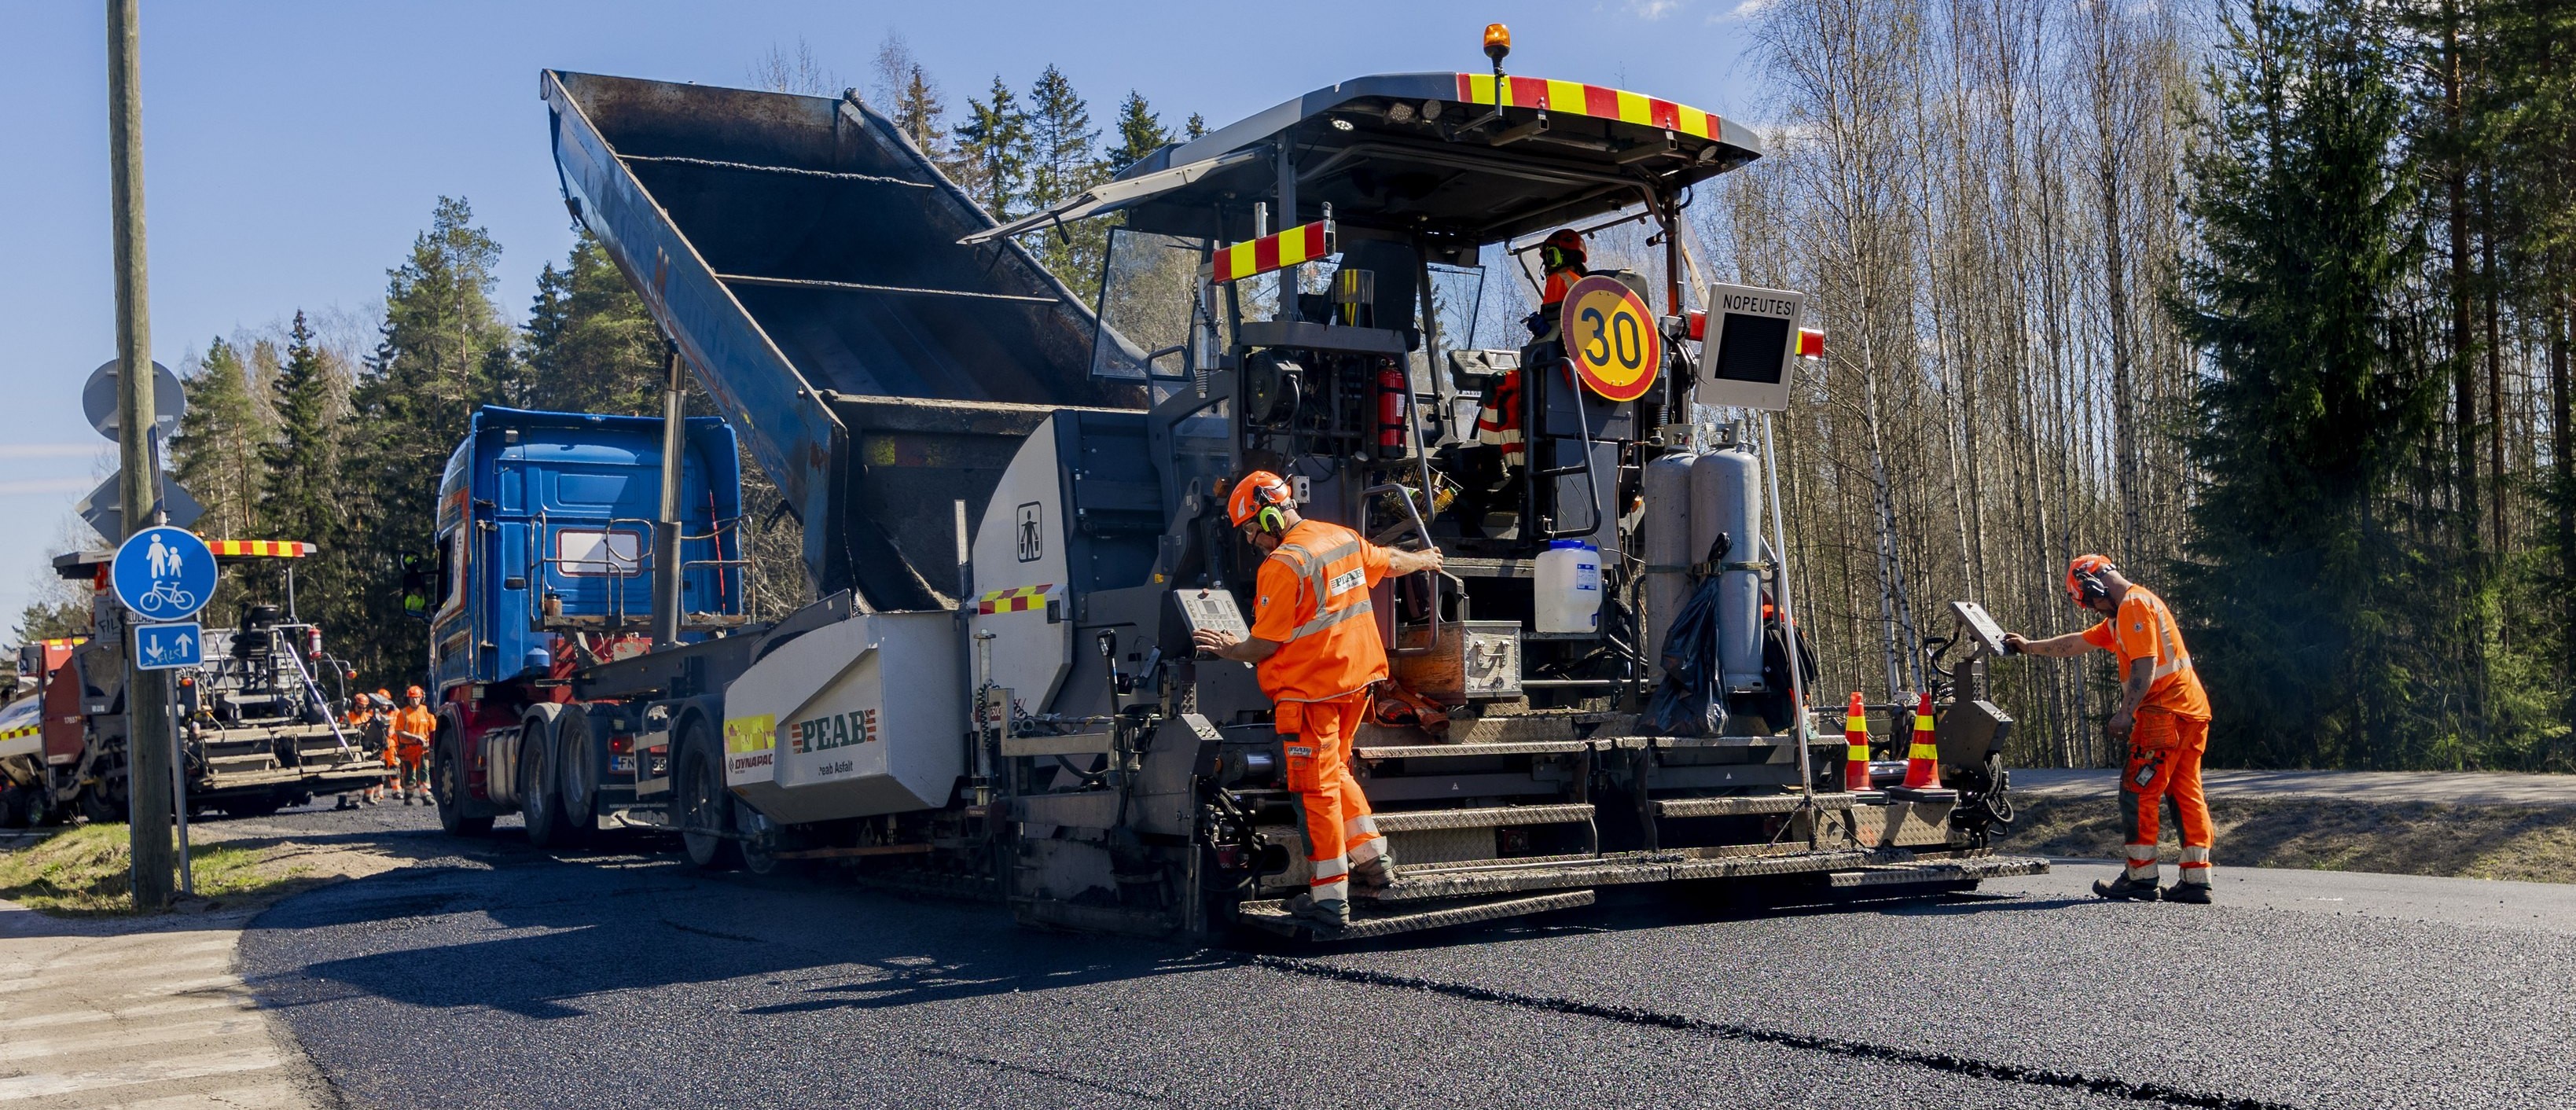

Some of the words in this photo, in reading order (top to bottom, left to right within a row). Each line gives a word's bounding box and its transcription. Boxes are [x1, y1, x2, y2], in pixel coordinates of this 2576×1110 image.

[1723, 294, 1795, 316] NOPEUTESI
[1581, 307, 1641, 369] 30
[800, 710, 866, 753] PEAB
[735, 754, 774, 770] DYNAPAC
[835, 760, 854, 774] Asfalt
